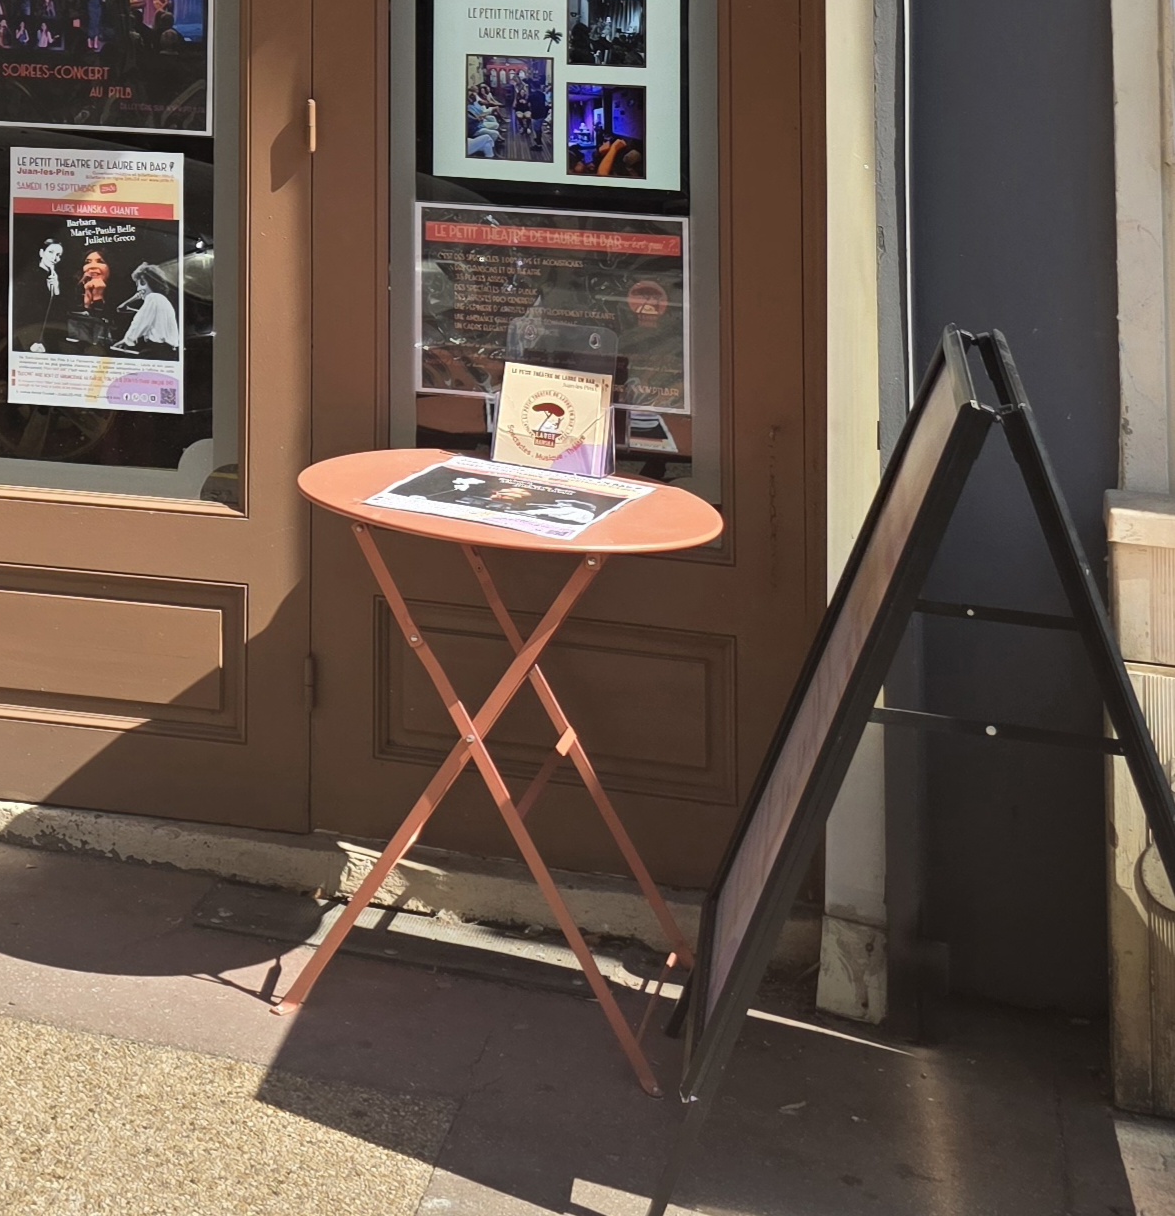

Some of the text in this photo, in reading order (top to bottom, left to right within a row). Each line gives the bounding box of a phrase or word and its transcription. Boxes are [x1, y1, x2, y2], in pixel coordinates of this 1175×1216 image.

[468, 7, 553, 21] LE PETIT THEATRE DE
[478, 27, 540, 40] LAURE EN BAR
[2, 63, 110, 81] SOIREES-CONCERT
[89, 87, 133, 99] AU PTLB
[17, 157, 167, 172] LE PETIT THEATRE DE LAURE EN BAR
[17, 167, 75, 177] Juan-les-Pins
[17, 181, 42, 191] SAMEDI
[45, 182, 56, 191] 19
[51, 203, 139, 216] LAURE HANSKA CHANTE
[66, 219, 97, 227] Barbara
[70, 225, 136, 237] Marie-Paule Belle
[434, 224, 447, 237] LE
[449, 226, 478, 239] PETIT
[529, 230, 544, 242] DE
[546, 232, 580, 246] LAURE
[583, 233, 597, 247] EN
[84, 234, 136, 246] Juliette Greco
